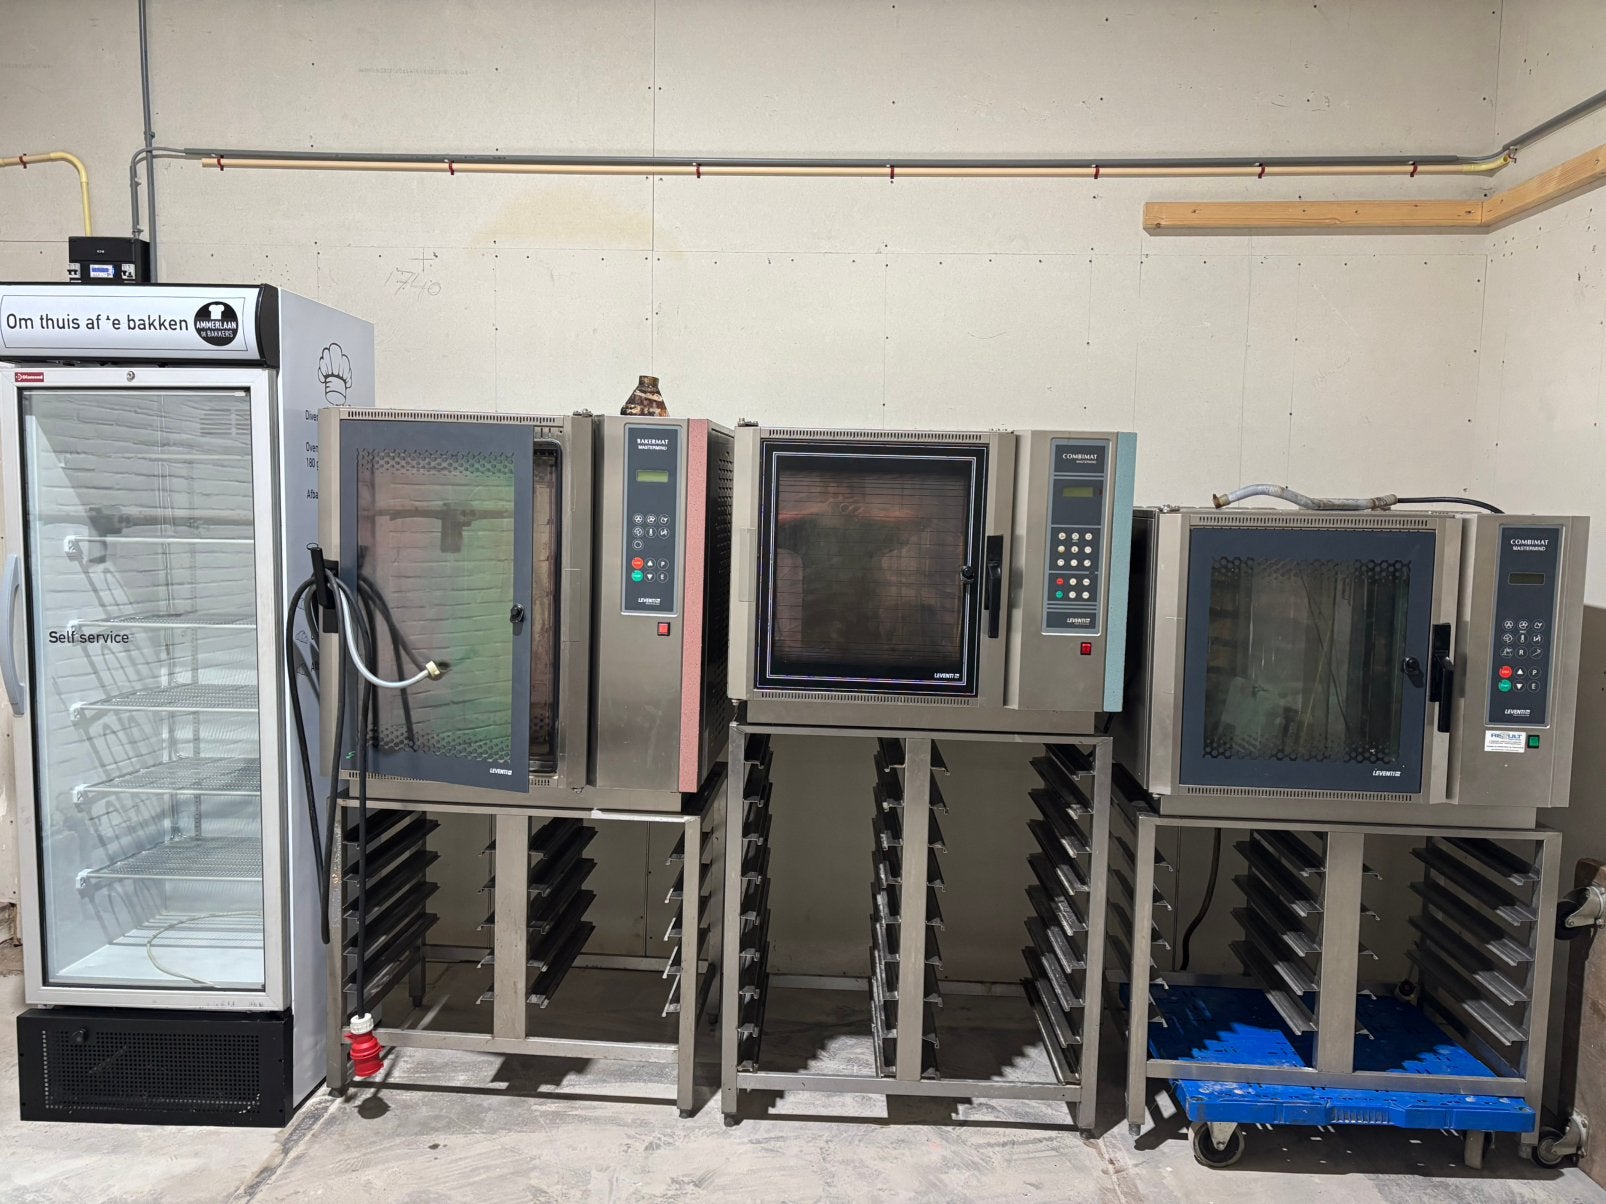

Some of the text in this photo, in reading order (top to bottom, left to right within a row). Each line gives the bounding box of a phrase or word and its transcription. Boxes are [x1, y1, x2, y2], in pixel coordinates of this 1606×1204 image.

[6, 313, 34, 330] Om
[39, 313, 80, 330] thuis
[85, 314, 101, 330] af
[127, 314, 189, 331] bakken
[196, 321, 237, 330] AMMERLAAN
[207, 330, 234, 338] BAKKERS
[306, 457, 316, 468] 180
[48, 630, 129, 644] Self service
[1531, 682, 1536, 690] E
